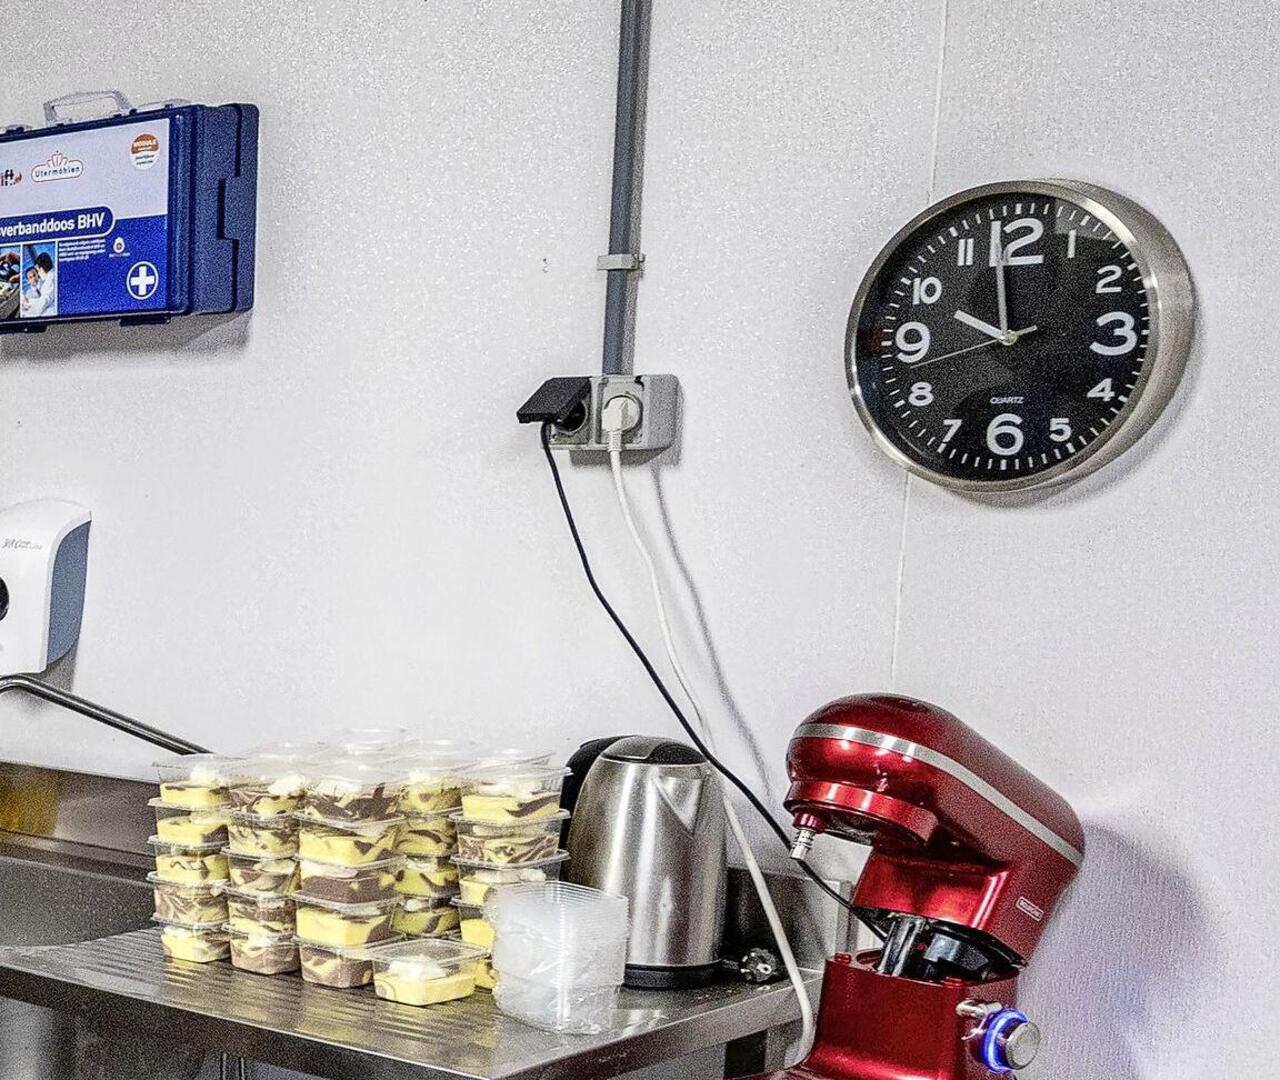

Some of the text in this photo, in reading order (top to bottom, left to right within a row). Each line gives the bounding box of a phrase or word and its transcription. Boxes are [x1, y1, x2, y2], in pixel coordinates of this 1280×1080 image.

[77, 212, 106, 230] BHV
[990, 218, 1044, 267] 12
[1066, 229, 1077, 258] 1
[912, 276, 942, 305] 10
[1095, 265, 1122, 293] 2
[895, 321, 931, 363] 9
[1089, 311, 1138, 356] 3
[908, 381, 934, 406] 8
[990, 396, 1024, 404] QUARTZ
[1086, 377, 1115, 401] 4
[942, 419, 962, 442] 7
[986, 412, 1024, 455] 6
[1049, 418, 1072, 441] 5
